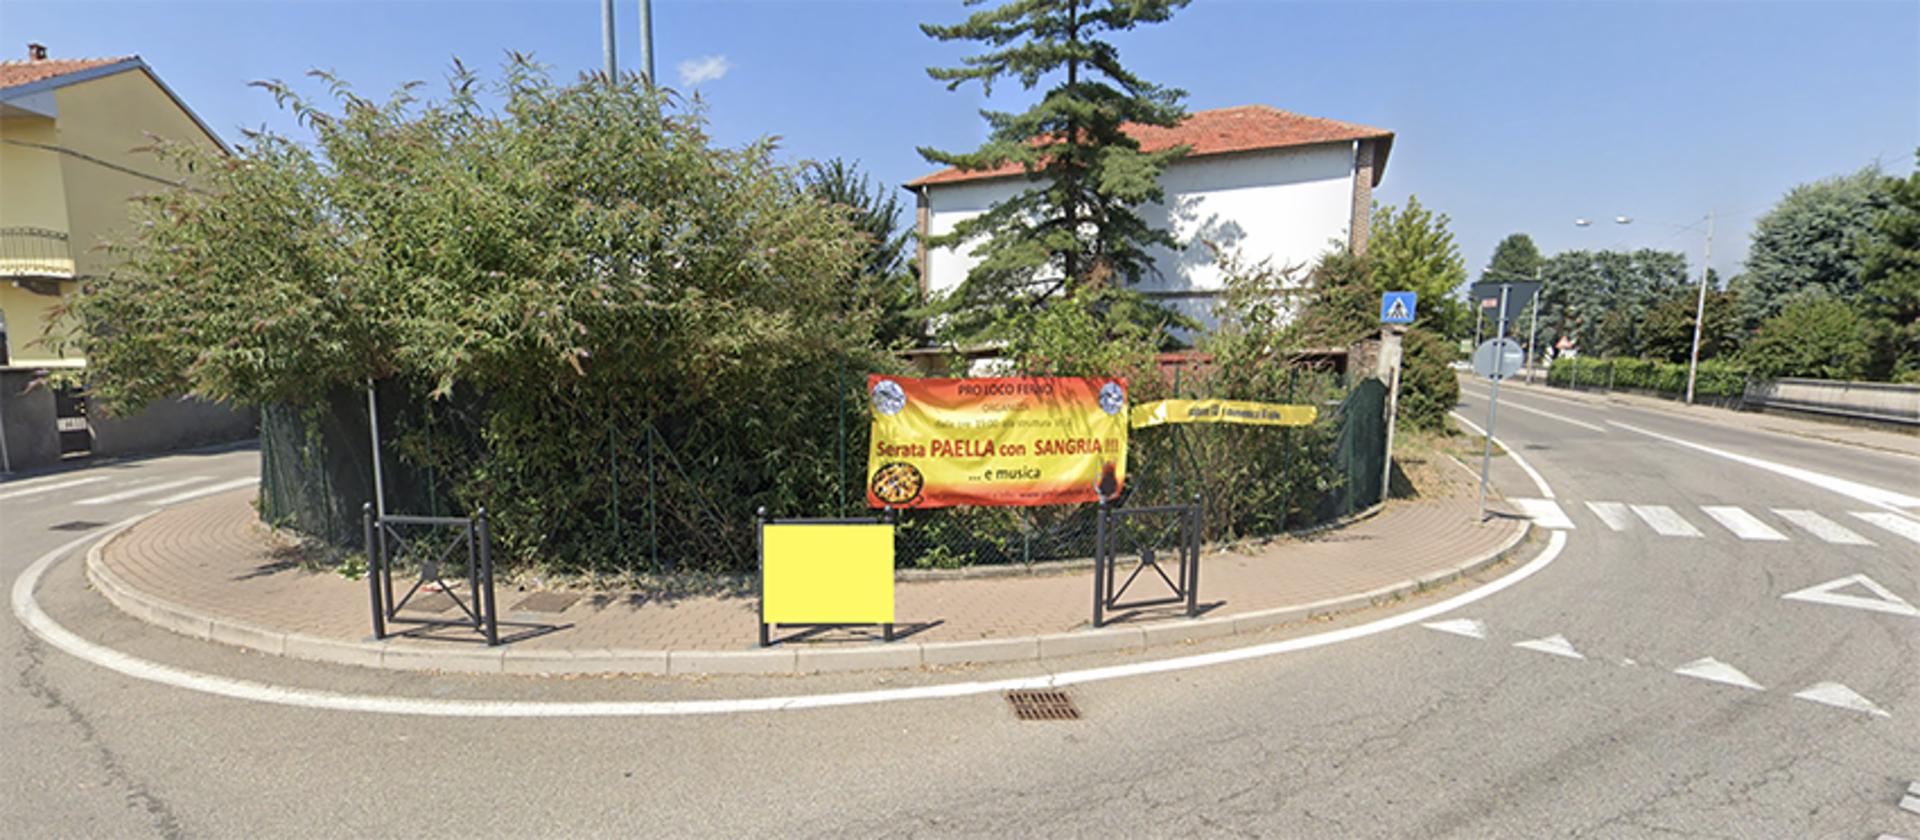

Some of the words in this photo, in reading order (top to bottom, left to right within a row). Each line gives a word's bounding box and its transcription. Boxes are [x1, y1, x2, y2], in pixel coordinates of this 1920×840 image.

[958, 383, 981, 396] PRO
[984, 383, 1015, 396] LOCO
[876, 441, 926, 457] Serata
[930, 439, 995, 457] PAELLA
[999, 444, 1026, 457] con
[1034, 439, 1102, 456] SANGRIA
[984, 469, 993, 480] e
[996, 466, 1041, 480] musica
